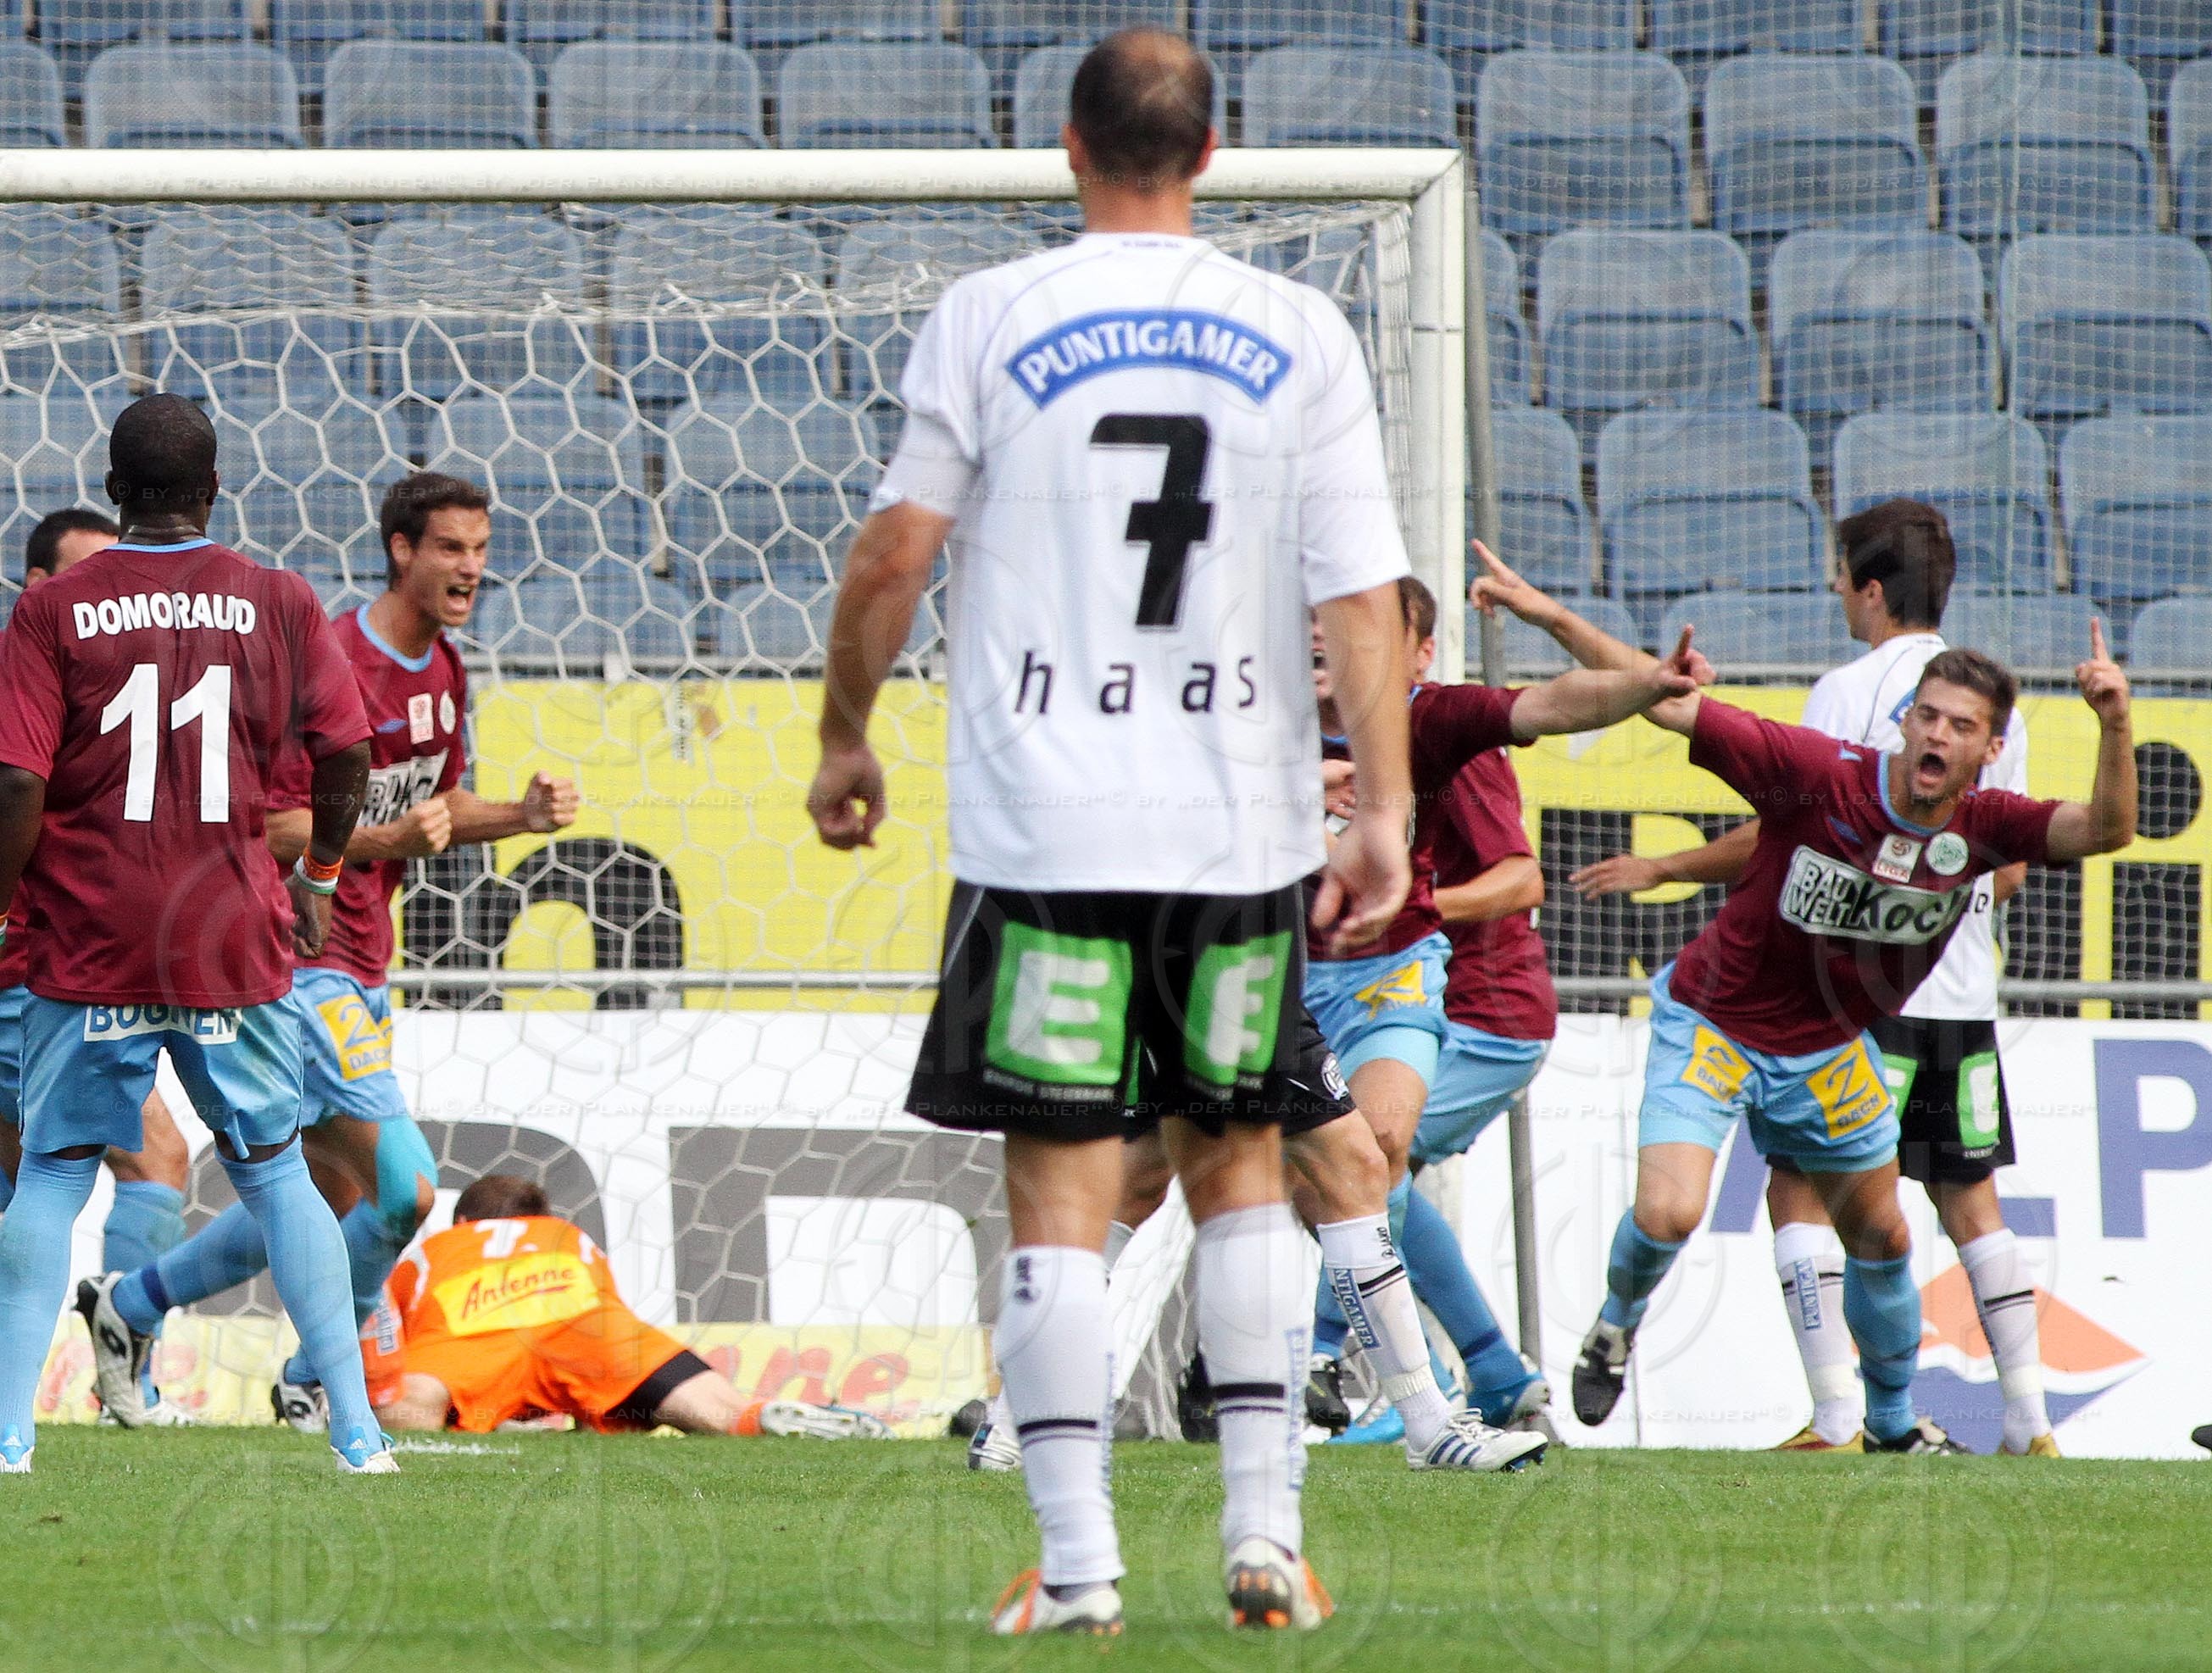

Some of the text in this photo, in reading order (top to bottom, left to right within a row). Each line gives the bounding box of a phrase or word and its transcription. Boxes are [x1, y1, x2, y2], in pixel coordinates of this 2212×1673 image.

[1018, 320, 1278, 393] PUNTIGAMER
[1090, 414, 1213, 630] 7
[72, 592, 256, 640] DOMORAUD
[1014, 651, 1258, 714] haas
[99, 664, 231, 824] 11
[1789, 884, 1854, 927] WELT
[1802, 861, 1853, 902] BAU
[1007, 950, 1111, 1065] E
[461, 1263, 574, 1320] Antenne
